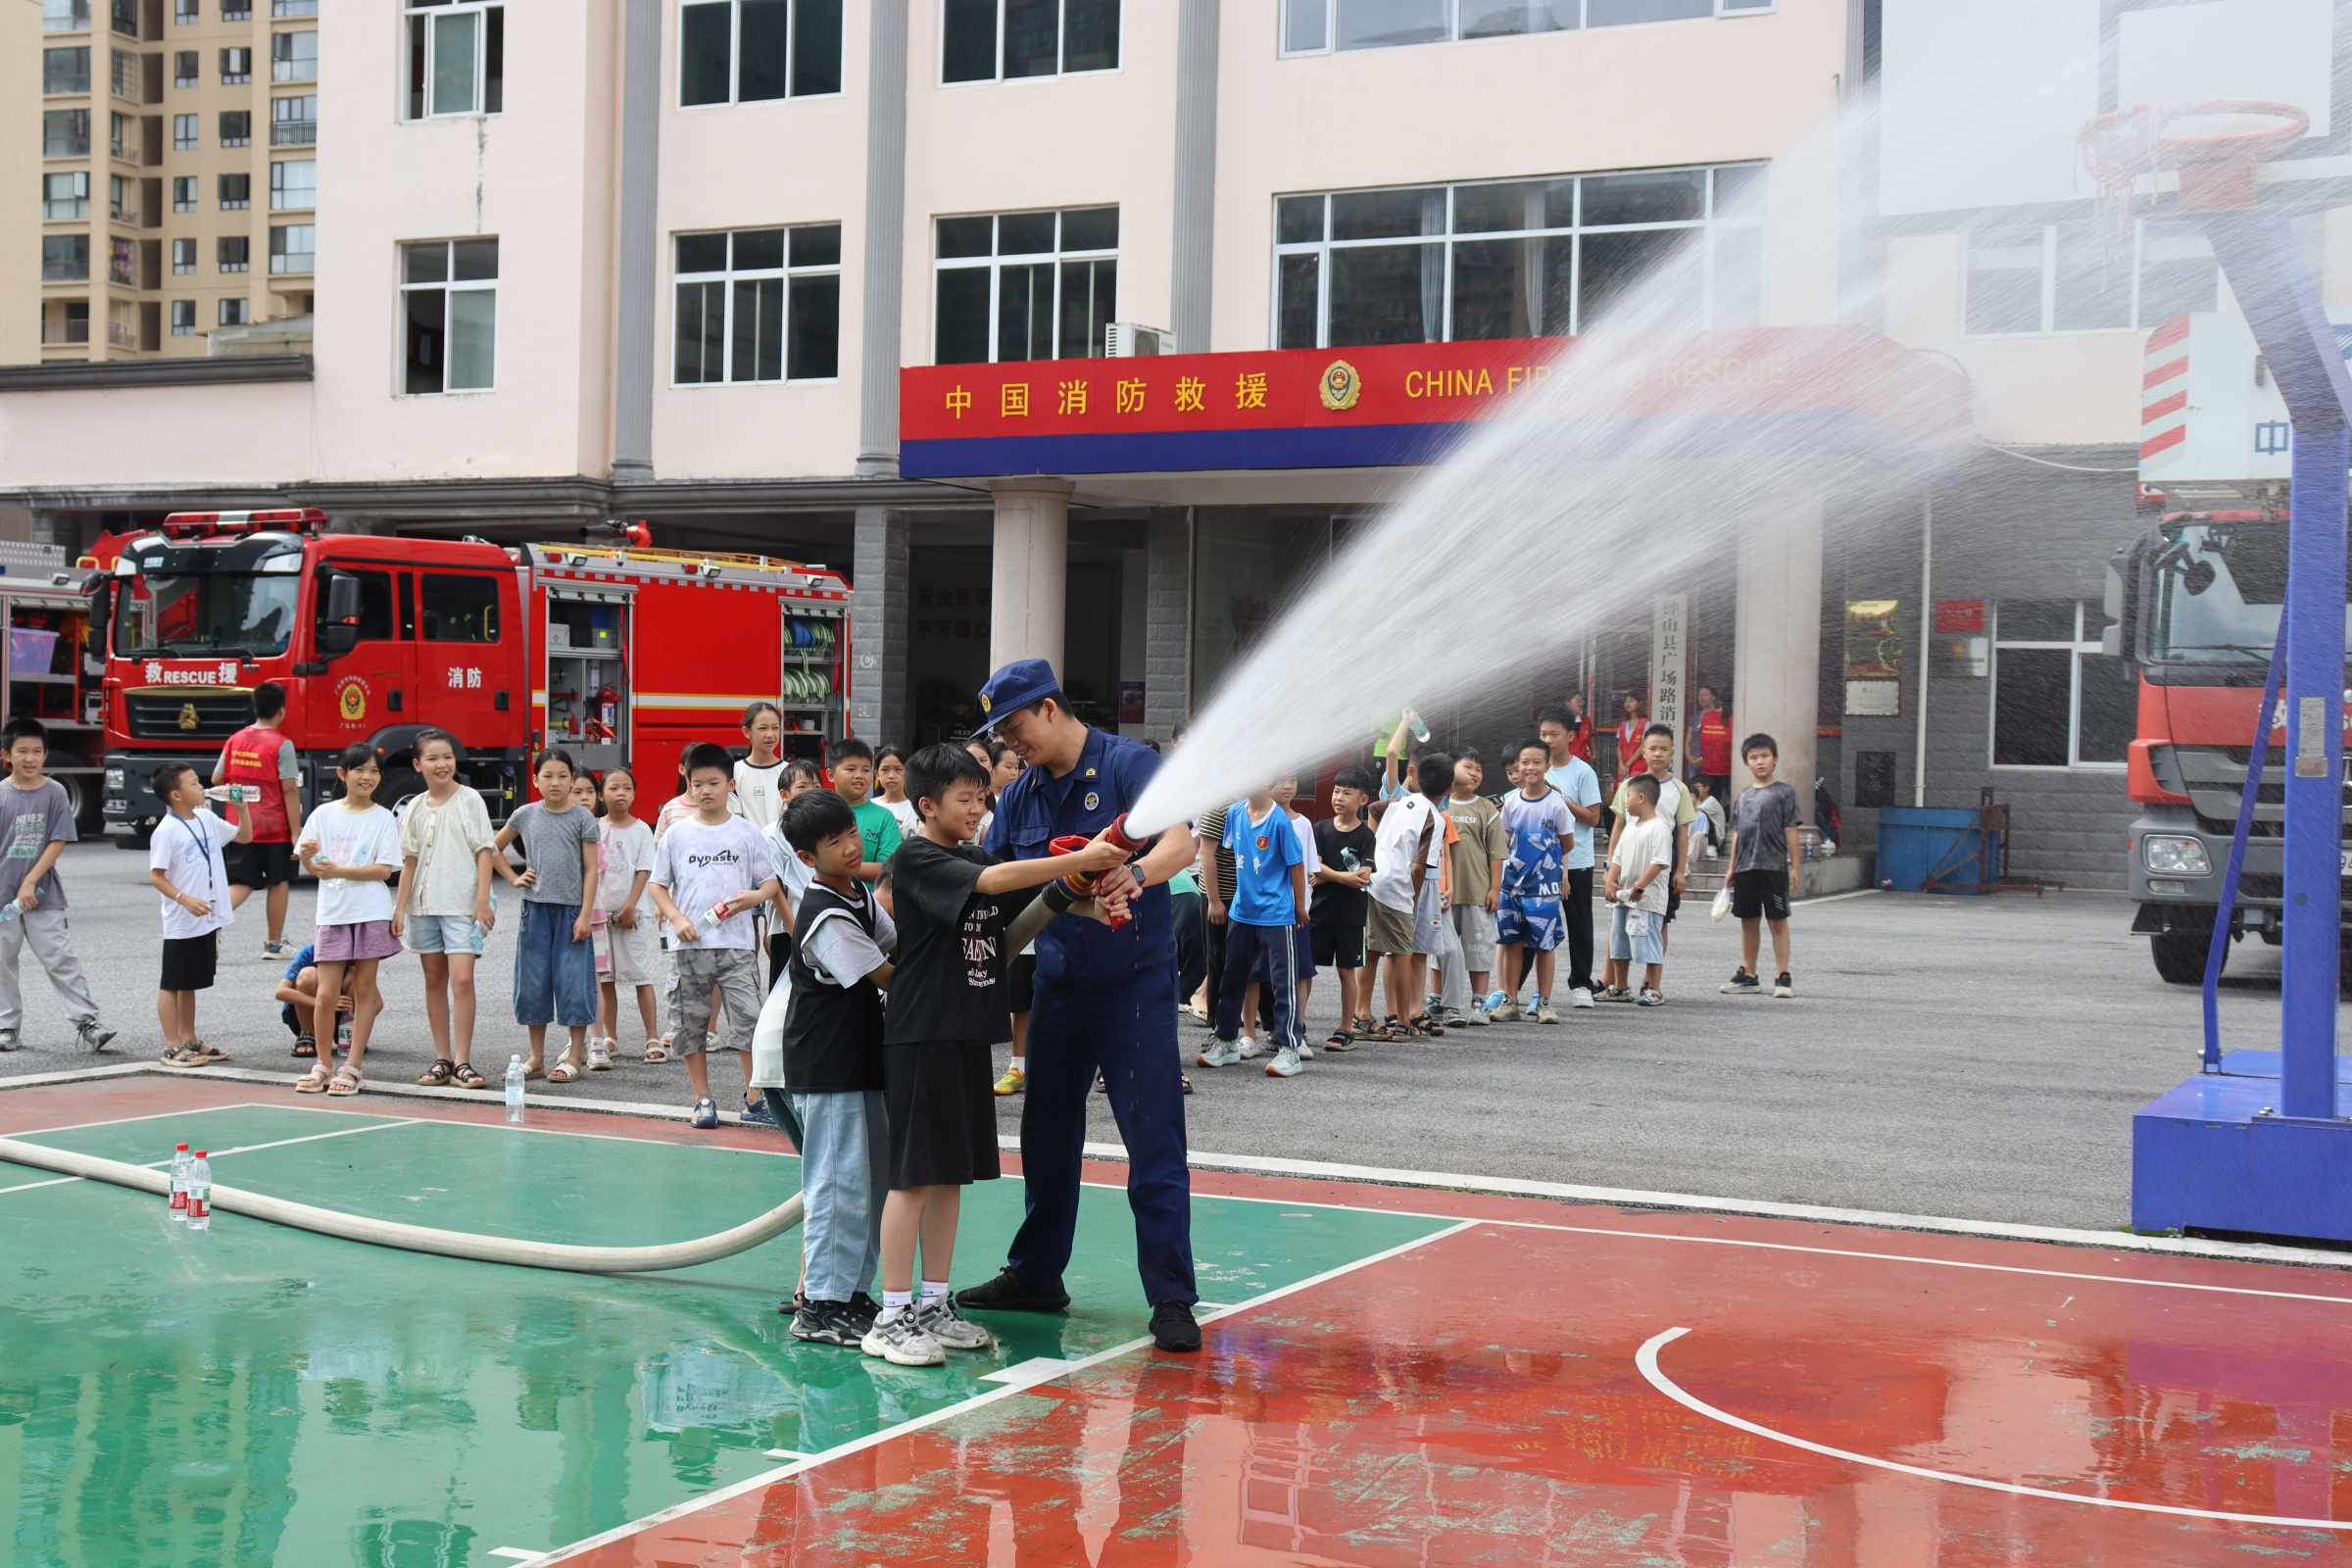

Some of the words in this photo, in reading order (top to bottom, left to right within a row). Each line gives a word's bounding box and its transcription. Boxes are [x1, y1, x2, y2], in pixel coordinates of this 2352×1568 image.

[1405, 368, 1494, 399] CHINA
[1507, 364, 1571, 394] FIRE
[1662, 357, 1787, 389] RESCUE
[945, 372, 1269, 419] 中国消防救援
[164, 671, 217, 684] RESCUE
[448, 666, 482, 688] 消防
[15, 812, 45, 824] NEVER
[689, 849, 740, 868] Dynasty
